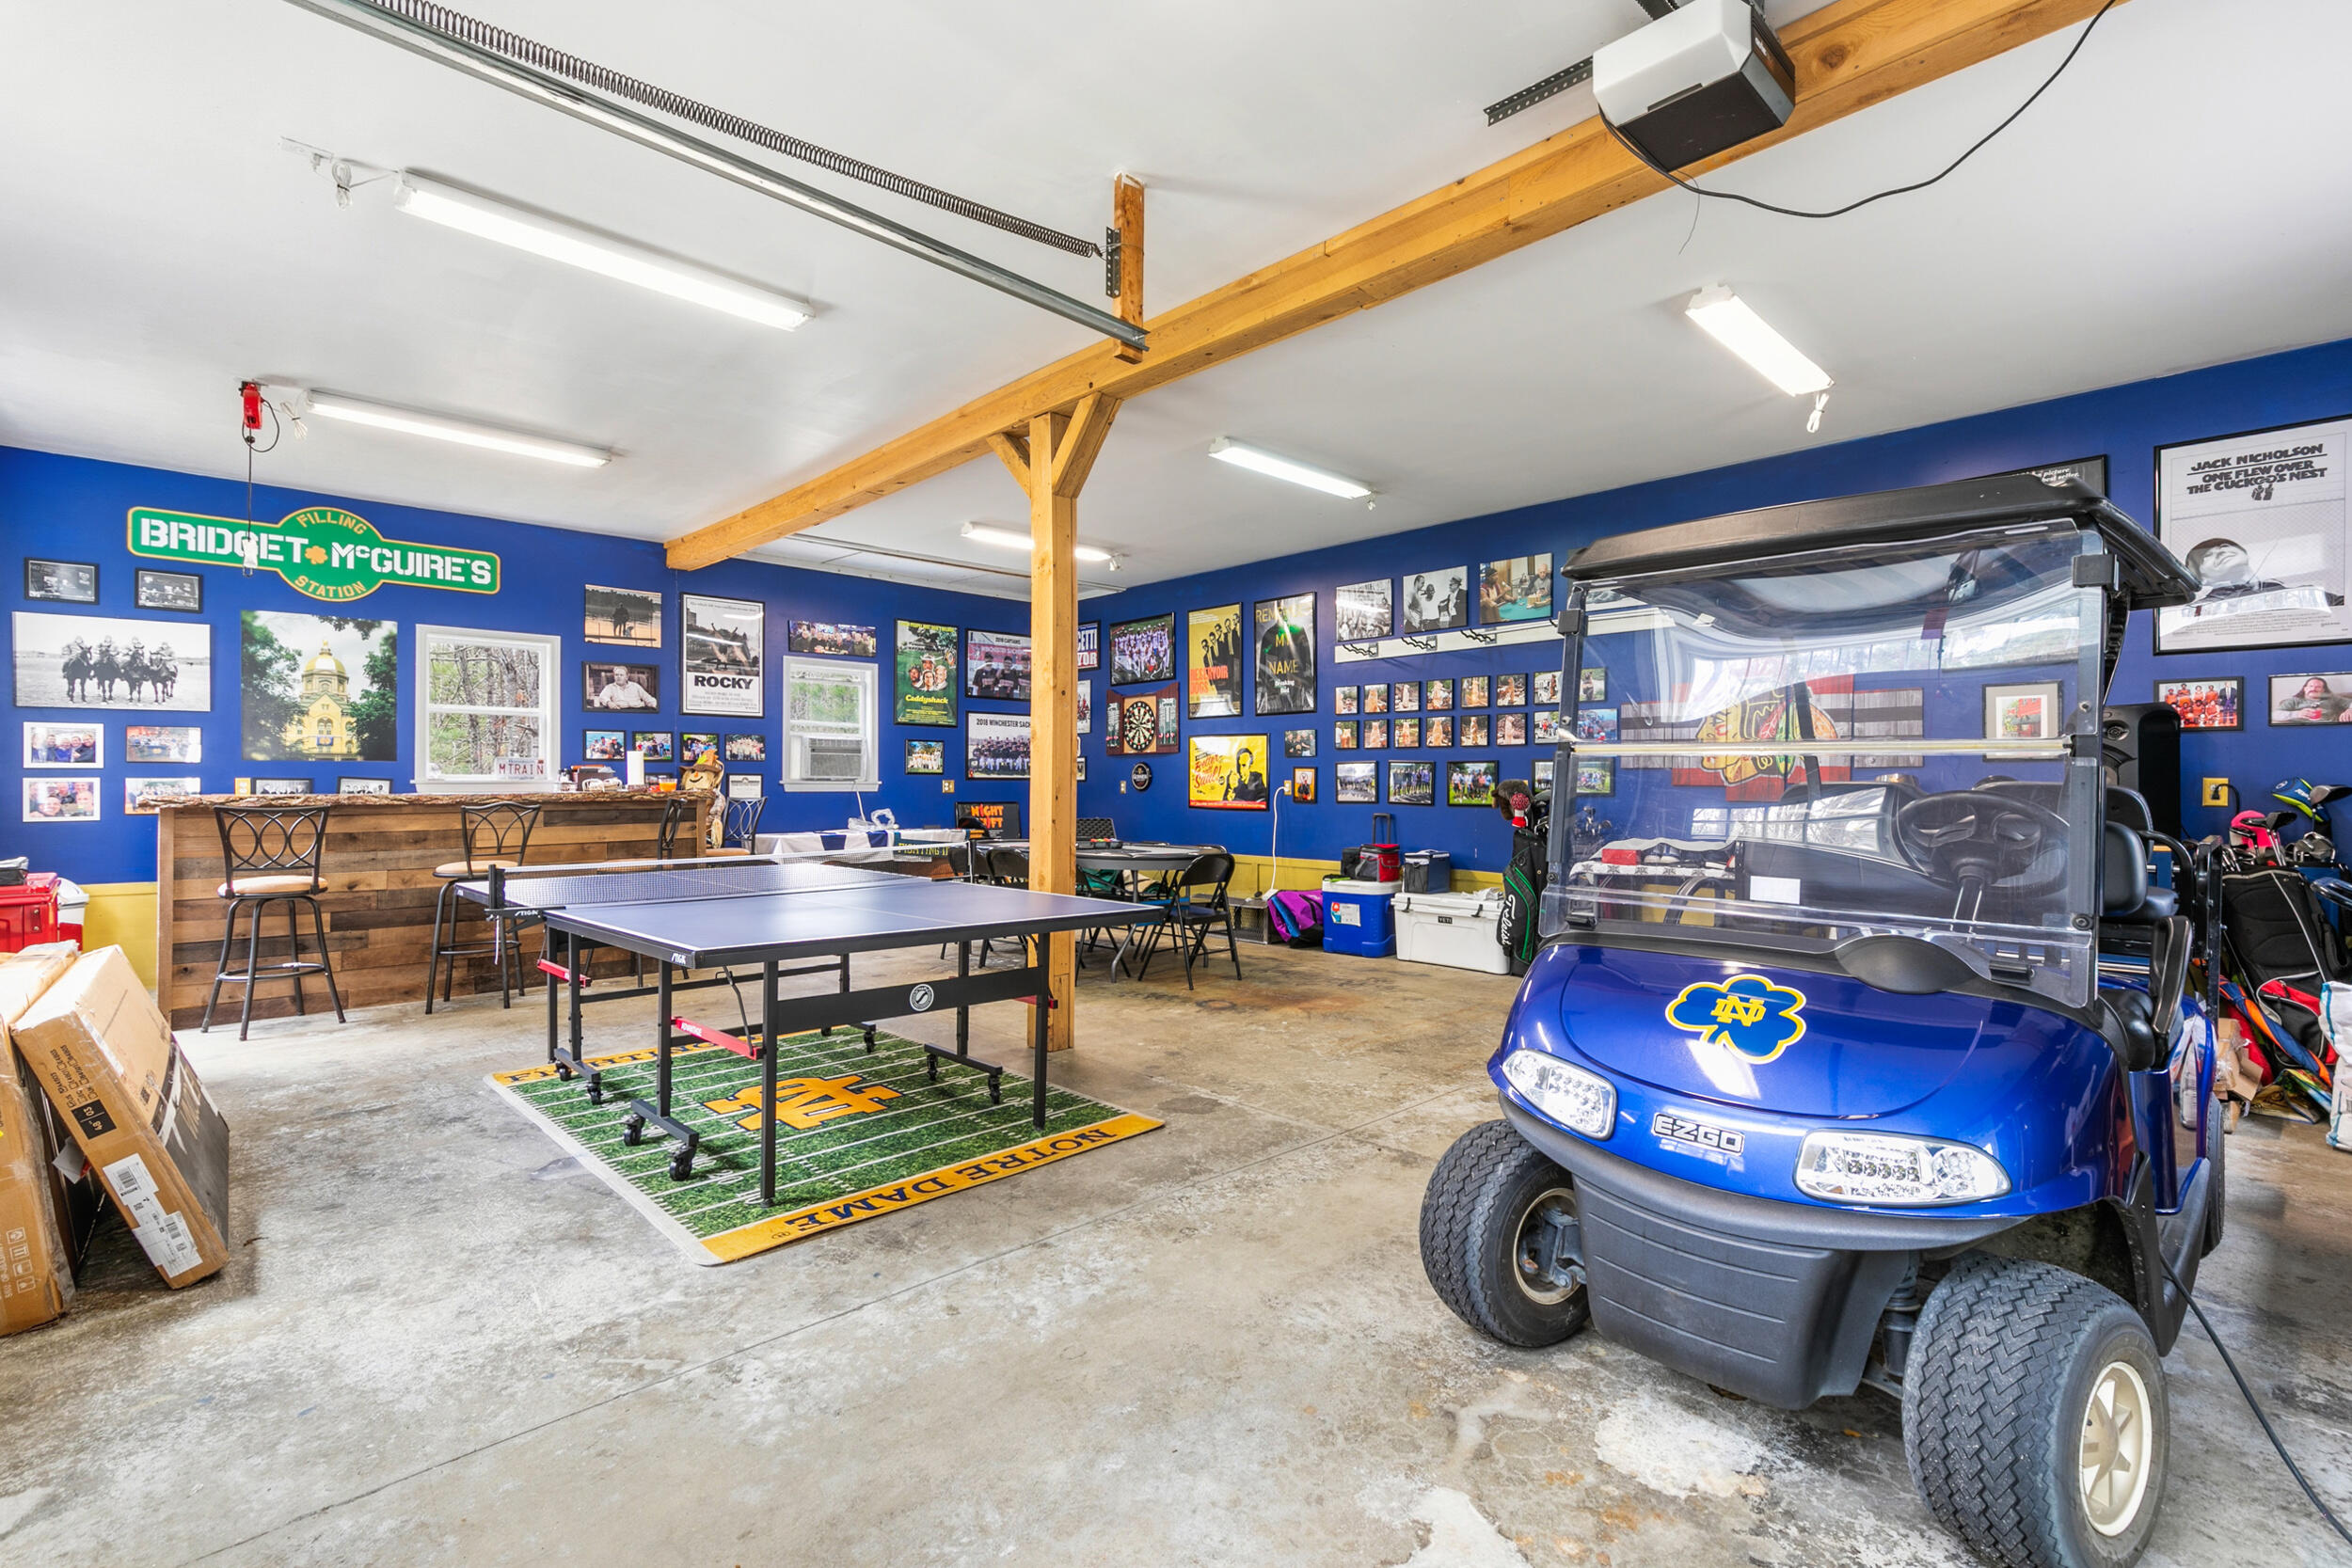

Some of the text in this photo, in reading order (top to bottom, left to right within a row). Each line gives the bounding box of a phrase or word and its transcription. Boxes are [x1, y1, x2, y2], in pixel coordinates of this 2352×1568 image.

[2191, 443, 2324, 471] JACK NICHOLSON
[2186, 467, 2328, 495] THE CUCKOO'S NEST
[2202, 460, 2314, 483] ONE FLEW OVER
[296, 511, 368, 535] FILLING
[294, 575, 367, 599] STATION
[1268, 659, 1300, 675] NAME
[693, 674, 754, 690] ROCKY
[905, 694, 949, 705] Caddyshack
[989, 719, 1019, 728] WINCHESTER
[970, 802, 1005, 817] NIGHT
[83, 1106, 94, 1117] 03
[784, 1128, 1118, 1232] NOTRE DAME
